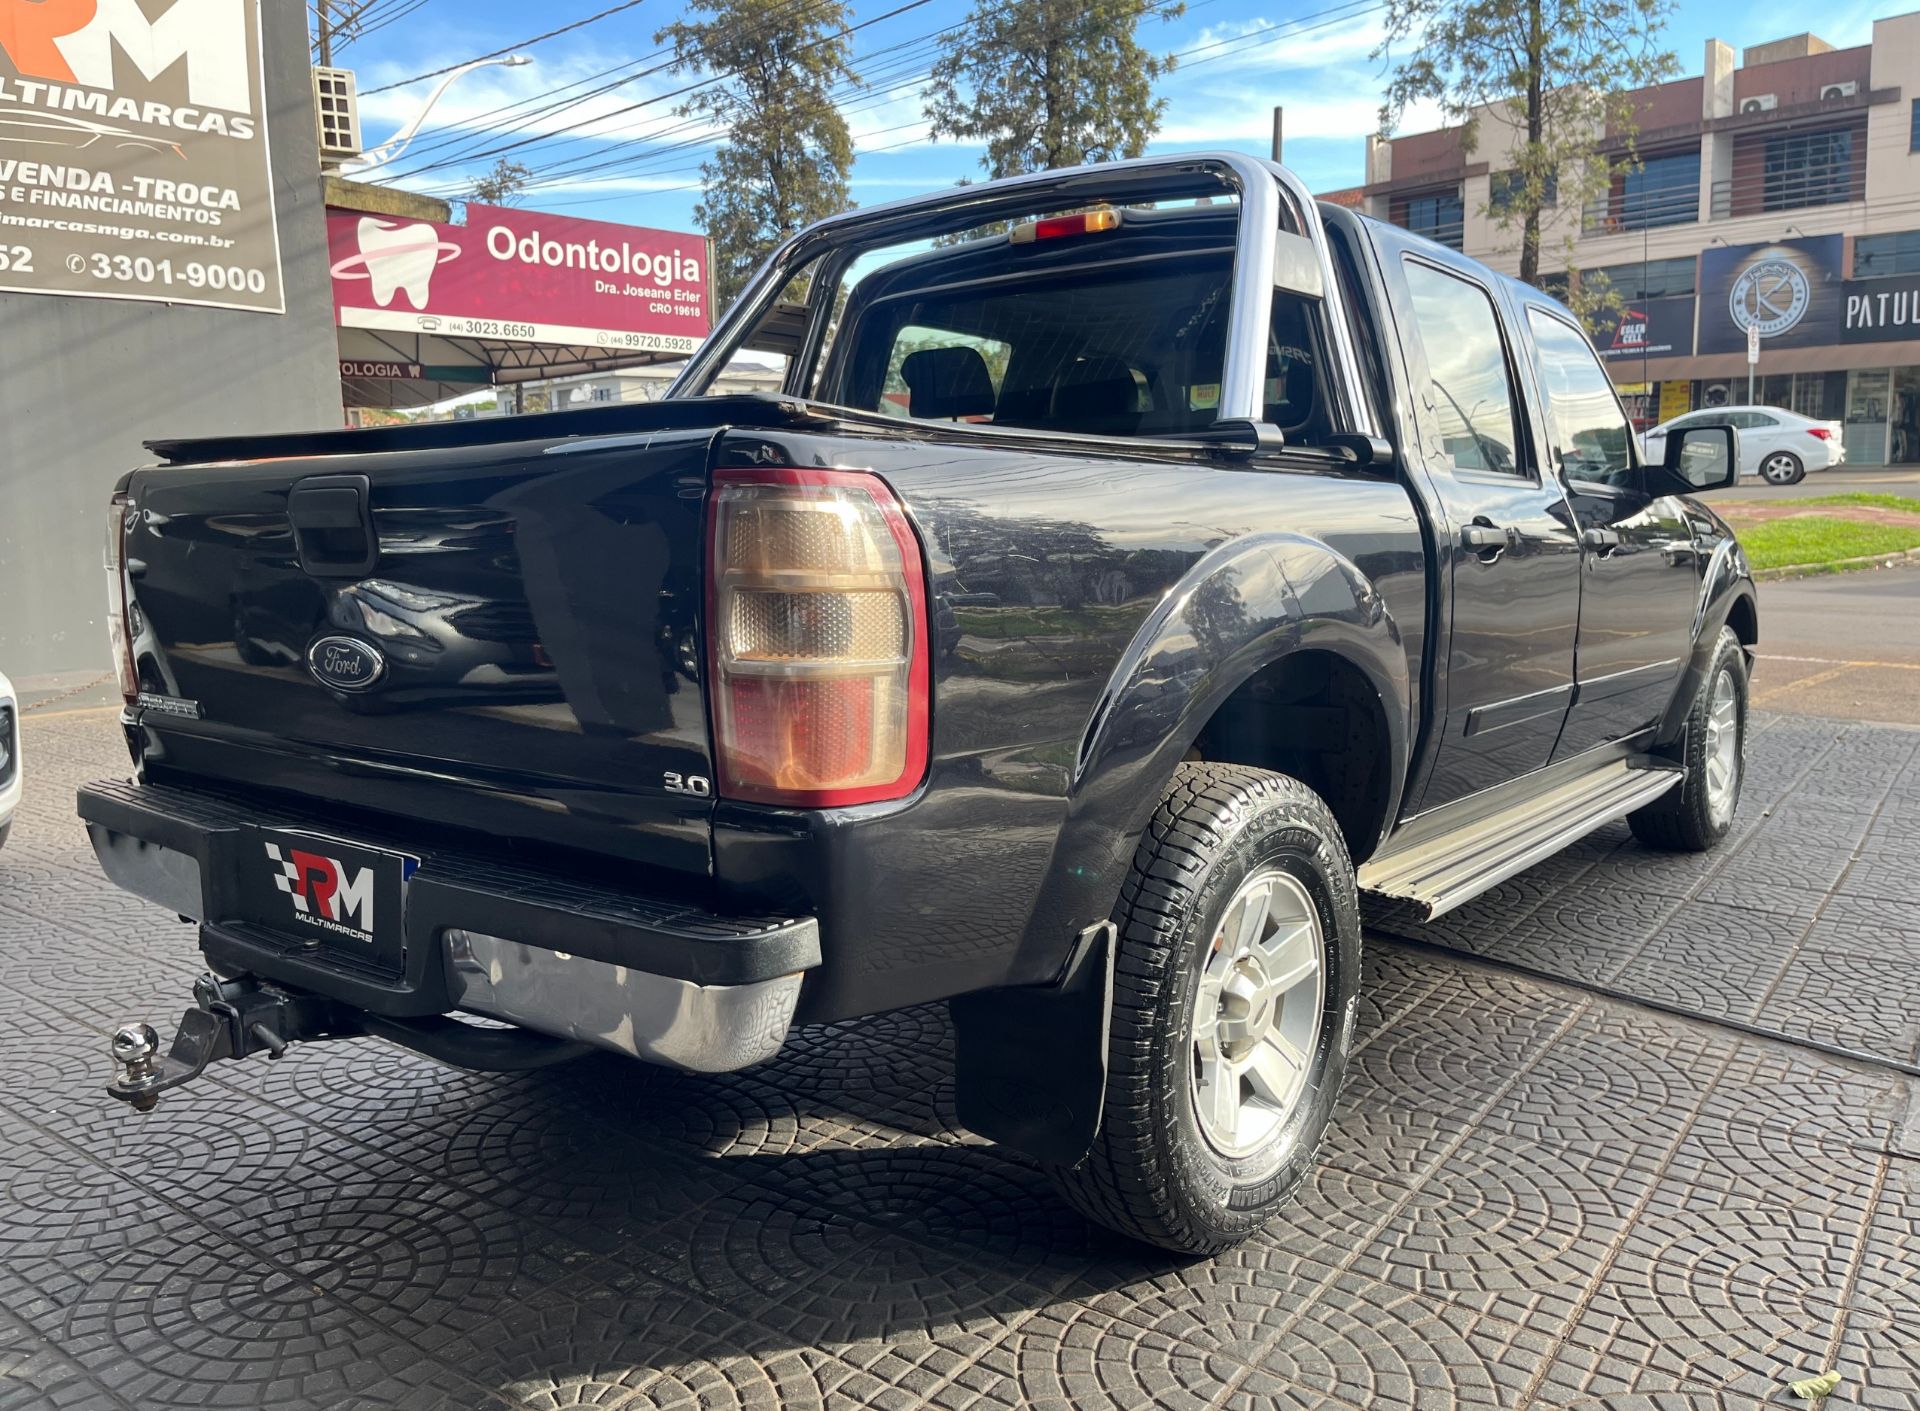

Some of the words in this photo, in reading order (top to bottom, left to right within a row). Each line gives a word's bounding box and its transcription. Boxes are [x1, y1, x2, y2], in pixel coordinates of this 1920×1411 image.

[0, 77, 254, 140] LTIMARCAS
[0, 159, 115, 194] VENDA
[11, 187, 25, 202] E
[30, 189, 222, 226] FINANCIAMENTOS
[486, 226, 700, 286] Odontologia
[90, 253, 265, 293] 3301-9000
[595, 279, 621, 295] Dra.
[622, 284, 672, 300] Joseane
[673, 288, 701, 303] Erler
[649, 302, 672, 315] CRO
[674, 305, 701, 317] 19618
[1846, 290, 1920, 329] PATUL
[449, 322, 463, 332] (44)
[465, 320, 536, 338] 3023.6650
[625, 334, 693, 351] 99720.5928
[340, 362, 402, 377] OLOGIA
[324, 646, 362, 676] Ford
[663, 771, 710, 797] 3.0
[290, 848, 374, 932] RM
[294, 911, 373, 943] MULTIMARCAS
[1231, 1164, 1292, 1207] MICHELIN
